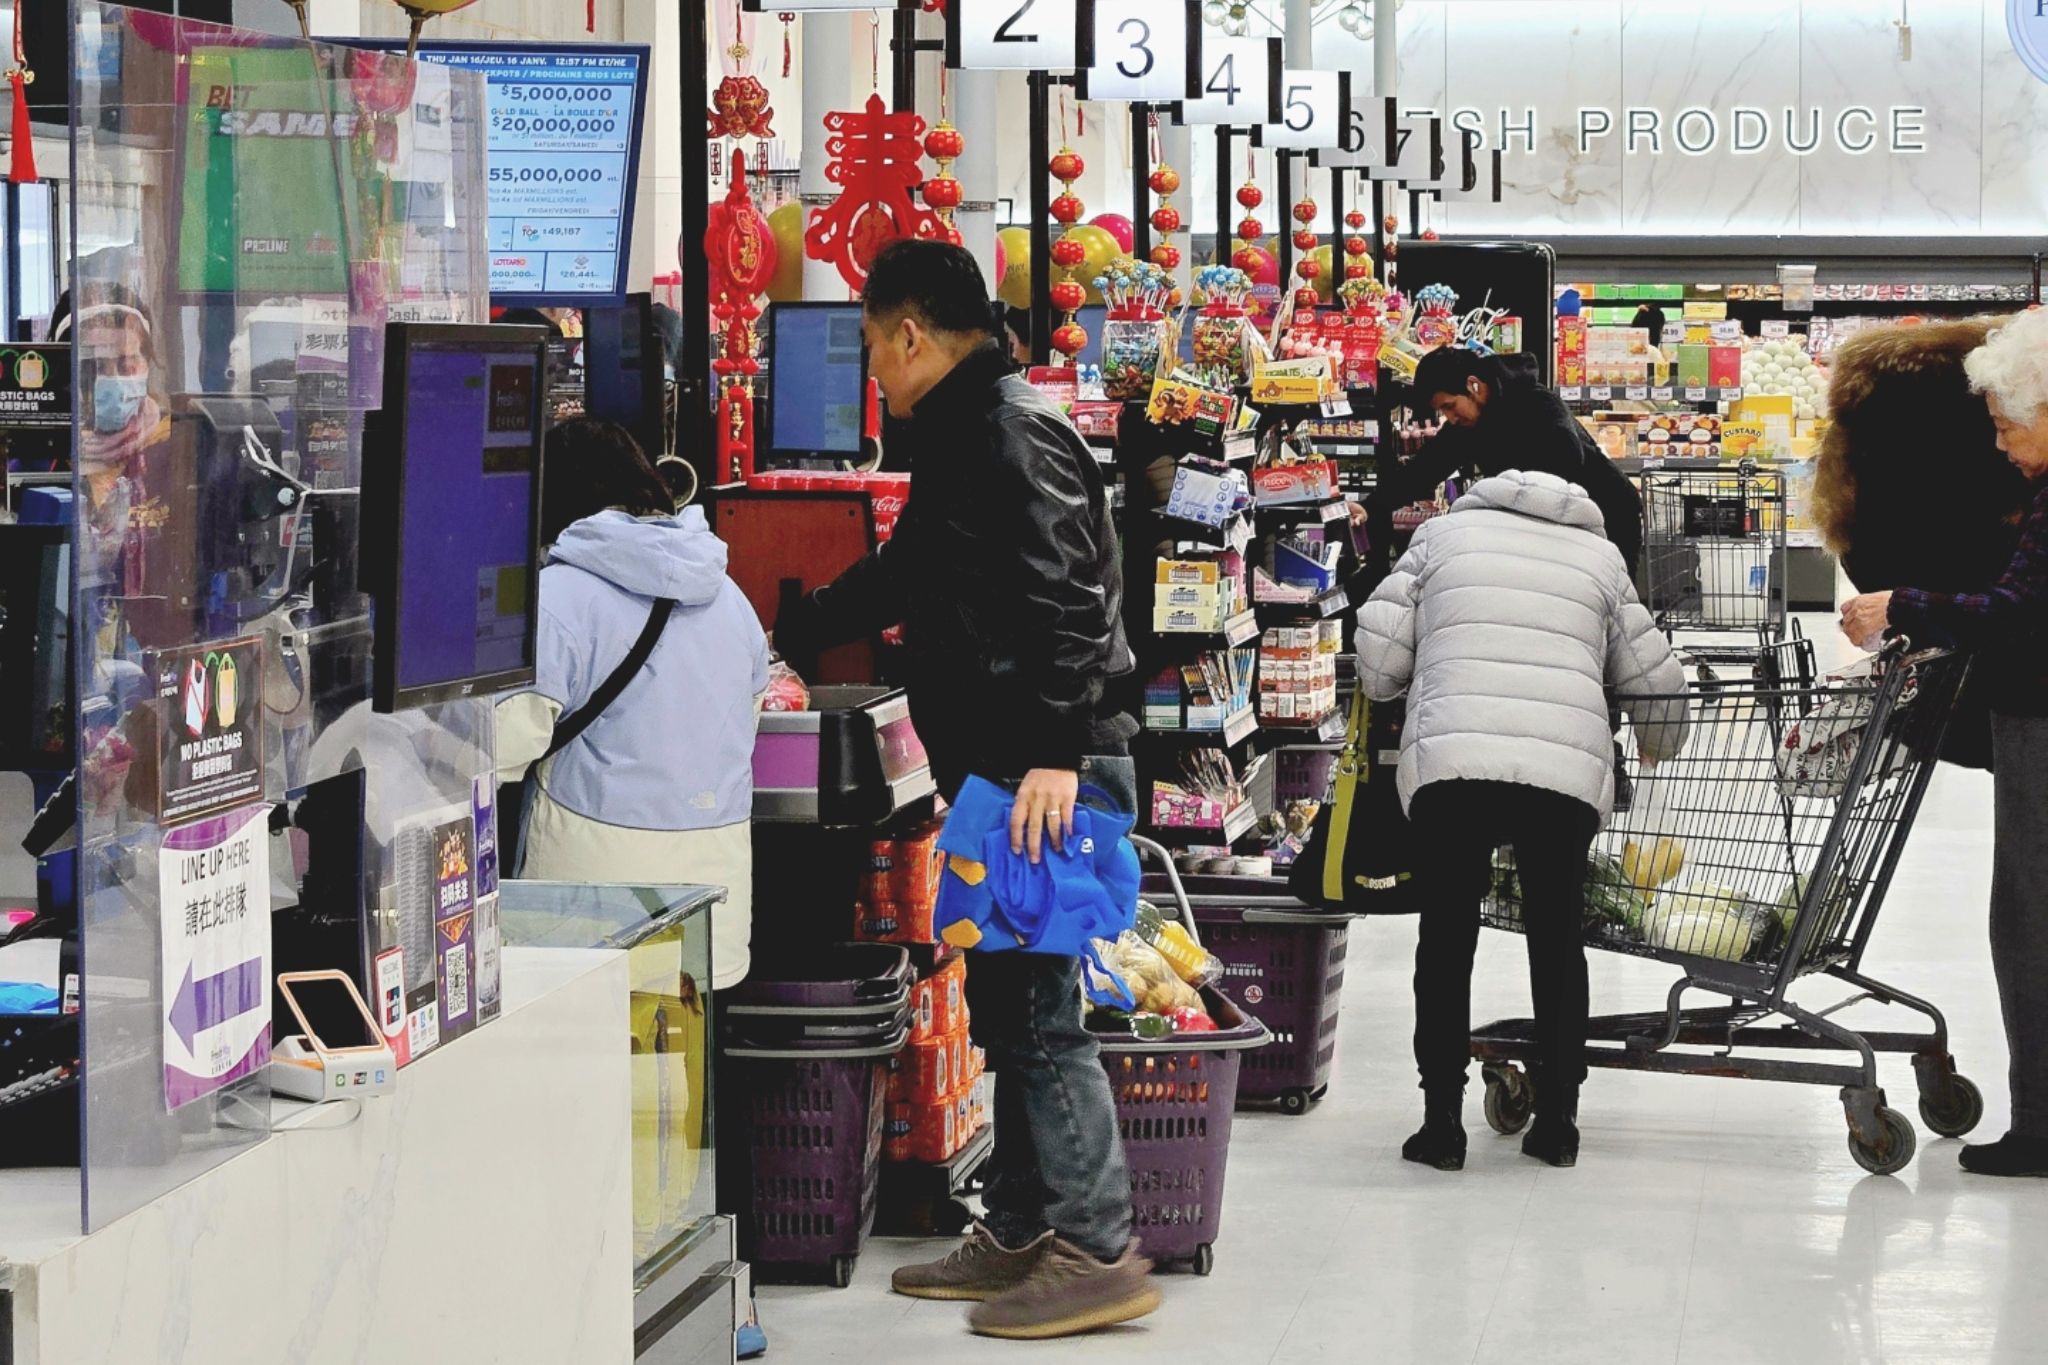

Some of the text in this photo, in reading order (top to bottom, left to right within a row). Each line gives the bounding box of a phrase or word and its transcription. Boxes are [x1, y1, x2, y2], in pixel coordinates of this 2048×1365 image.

[1116, 18, 1155, 79] 3
[426, 55, 446, 64] THU
[448, 56, 468, 64] JAN
[507, 57, 517, 65] 16
[520, 57, 547, 65] JANV.
[555, 57, 580, 66] 12:57
[583, 58, 597, 66] PM
[530, 70, 583, 79] PROCHAINS
[585, 71, 609, 79] GROS
[611, 71, 635, 80] LOTS
[1205, 54, 1241, 106] 4
[502, 84, 612, 101] $5,000,000
[519, 108, 540, 117] BALL
[567, 109, 592, 117] BOULE
[1284, 85, 1314, 132] 5
[492, 116, 616, 134] $20,000,000
[1579, 108, 1928, 154] PRODUCE
[386, 307, 421, 322] Cash
[26, 391, 55, 401] BAGS
[1723, 427, 1762, 438] CUSTARD
[181, 731, 243, 762] NO PLASTIC BAGS
[181, 838, 250, 885] LINE UP HERE
[184, 881, 247, 938] 請在此排隊
[863, 919, 898, 932] FANTA
